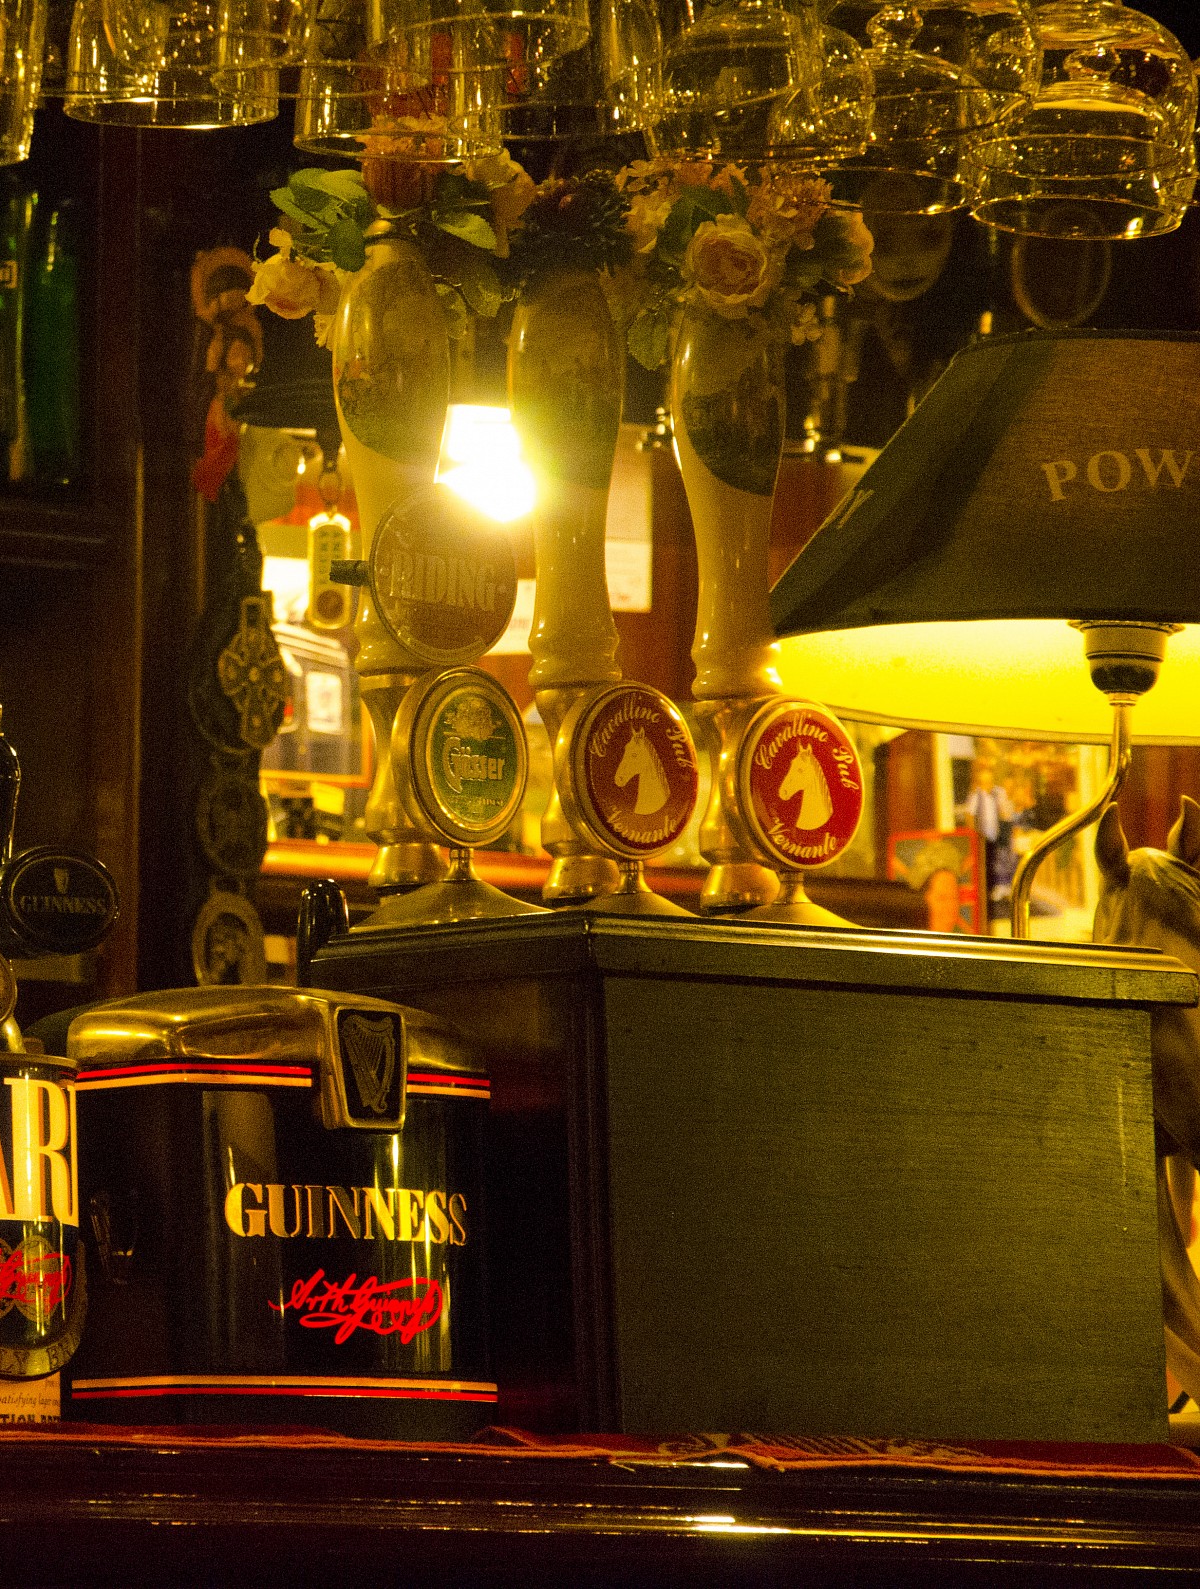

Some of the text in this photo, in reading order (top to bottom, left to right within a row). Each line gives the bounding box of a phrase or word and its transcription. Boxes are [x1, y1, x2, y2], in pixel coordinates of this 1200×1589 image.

[1041, 447, 1195, 502] POW
[590, 693, 696, 770] Cavallino Pub
[753, 713, 860, 791] Cavallino Pub
[607, 804, 679, 844] Vernante
[766, 816, 838, 859] Vernante
[20, 894, 108, 915] GUINNESS
[224, 1182, 468, 1247] GUINNESS
